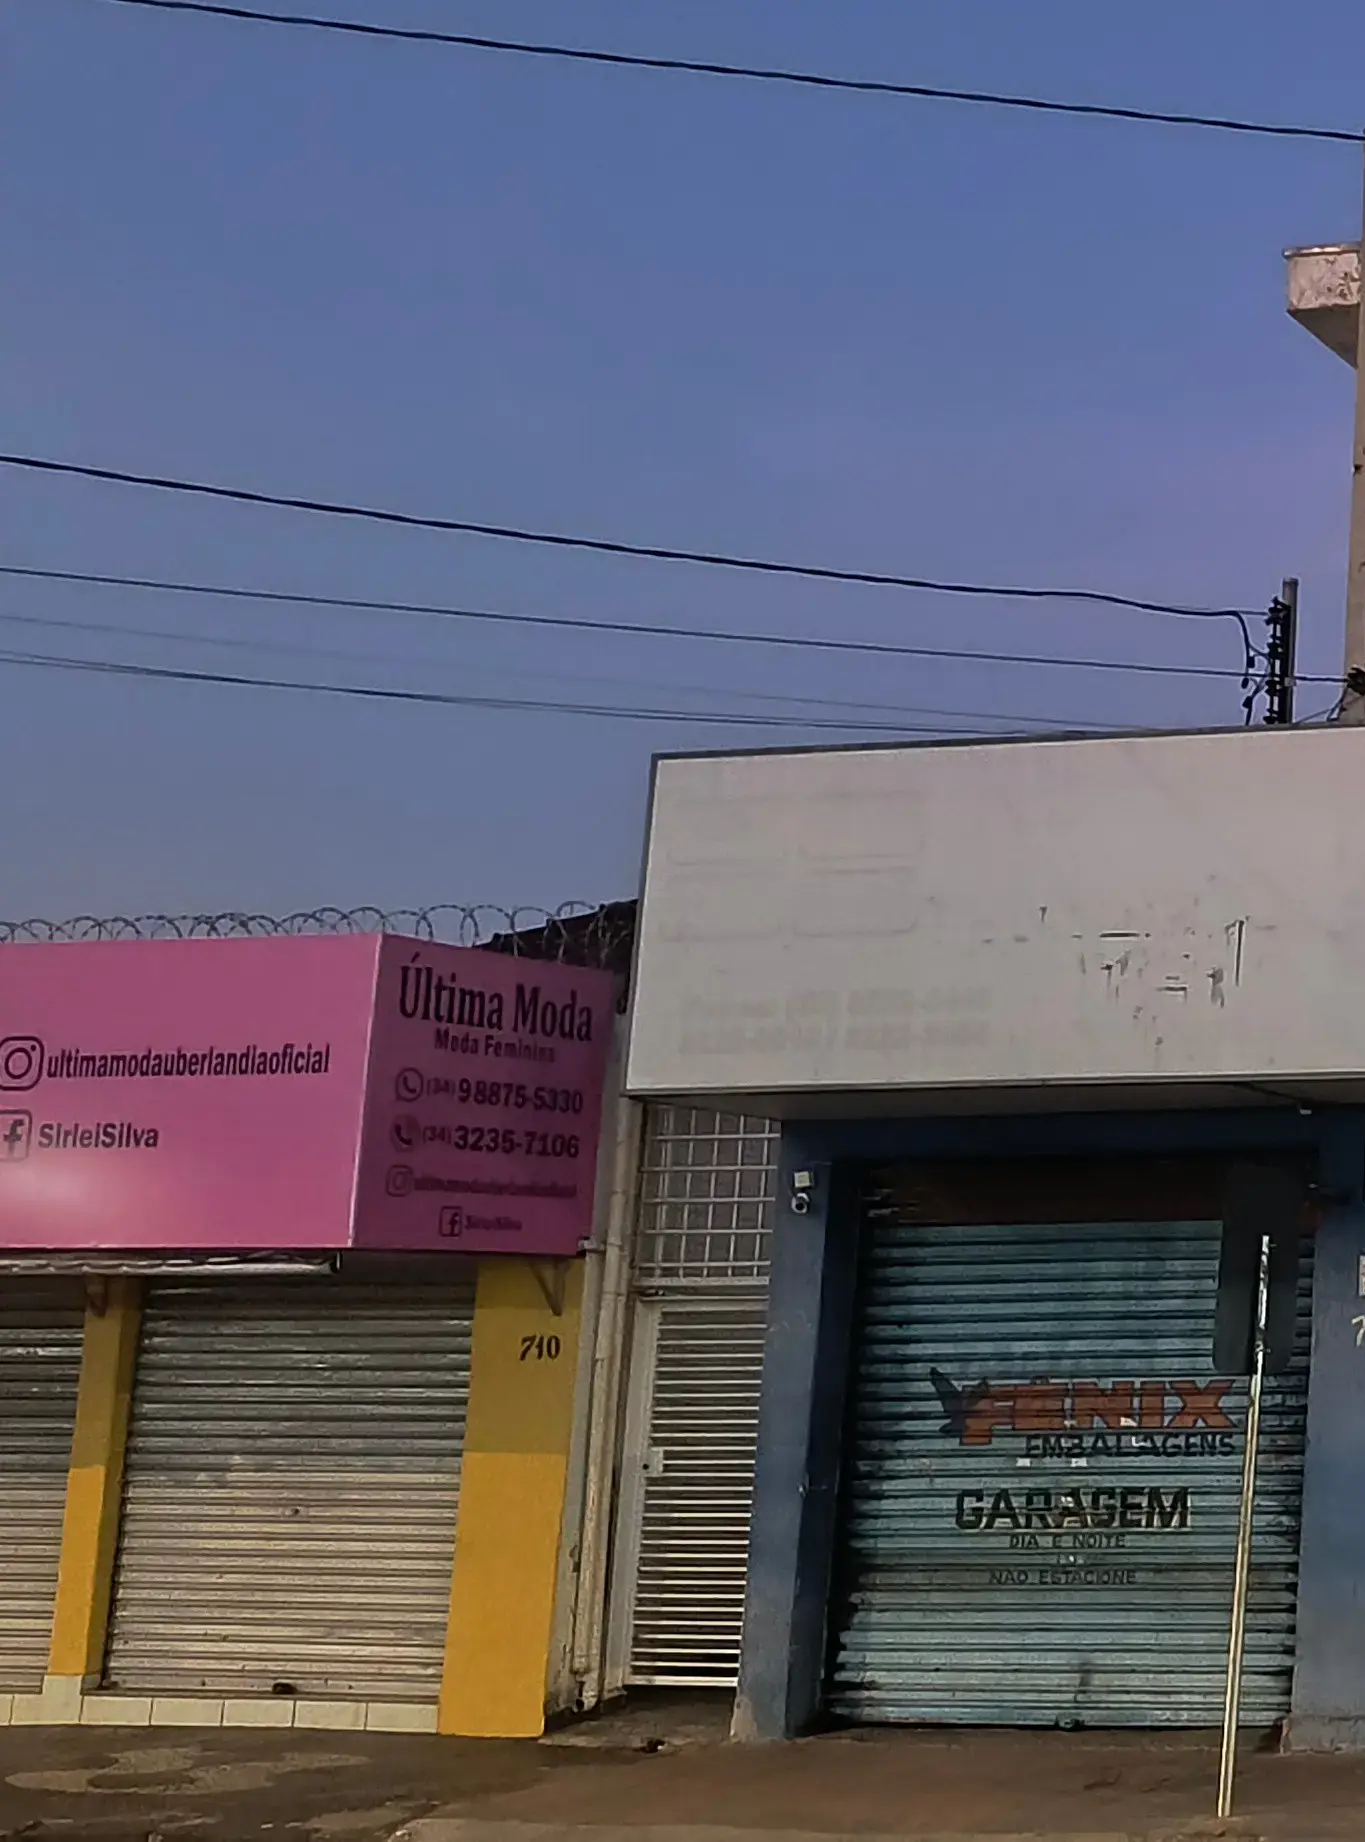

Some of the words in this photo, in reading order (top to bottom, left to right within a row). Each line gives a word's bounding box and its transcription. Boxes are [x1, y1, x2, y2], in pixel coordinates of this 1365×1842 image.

[399, 951, 504, 1031] Última
[512, 983, 593, 1042] Moda
[434, 1026, 479, 1055] Moda
[46, 1043, 331, 1079] ultimamodauberlandiaoficial
[454, 1125, 581, 1159] 3235-7106
[519, 1334, 561, 1362] 710
[1025, 1433, 1237, 1459] EMBALAGENS
[954, 1487, 1191, 1530] GARAGEM
[1009, 1533, 1040, 1549] DIA
[1051, 1533, 1063, 1549] E
[1072, 1532, 1127, 1548] NOITE
[1038, 1567, 1137, 1585] ESTACIONE
